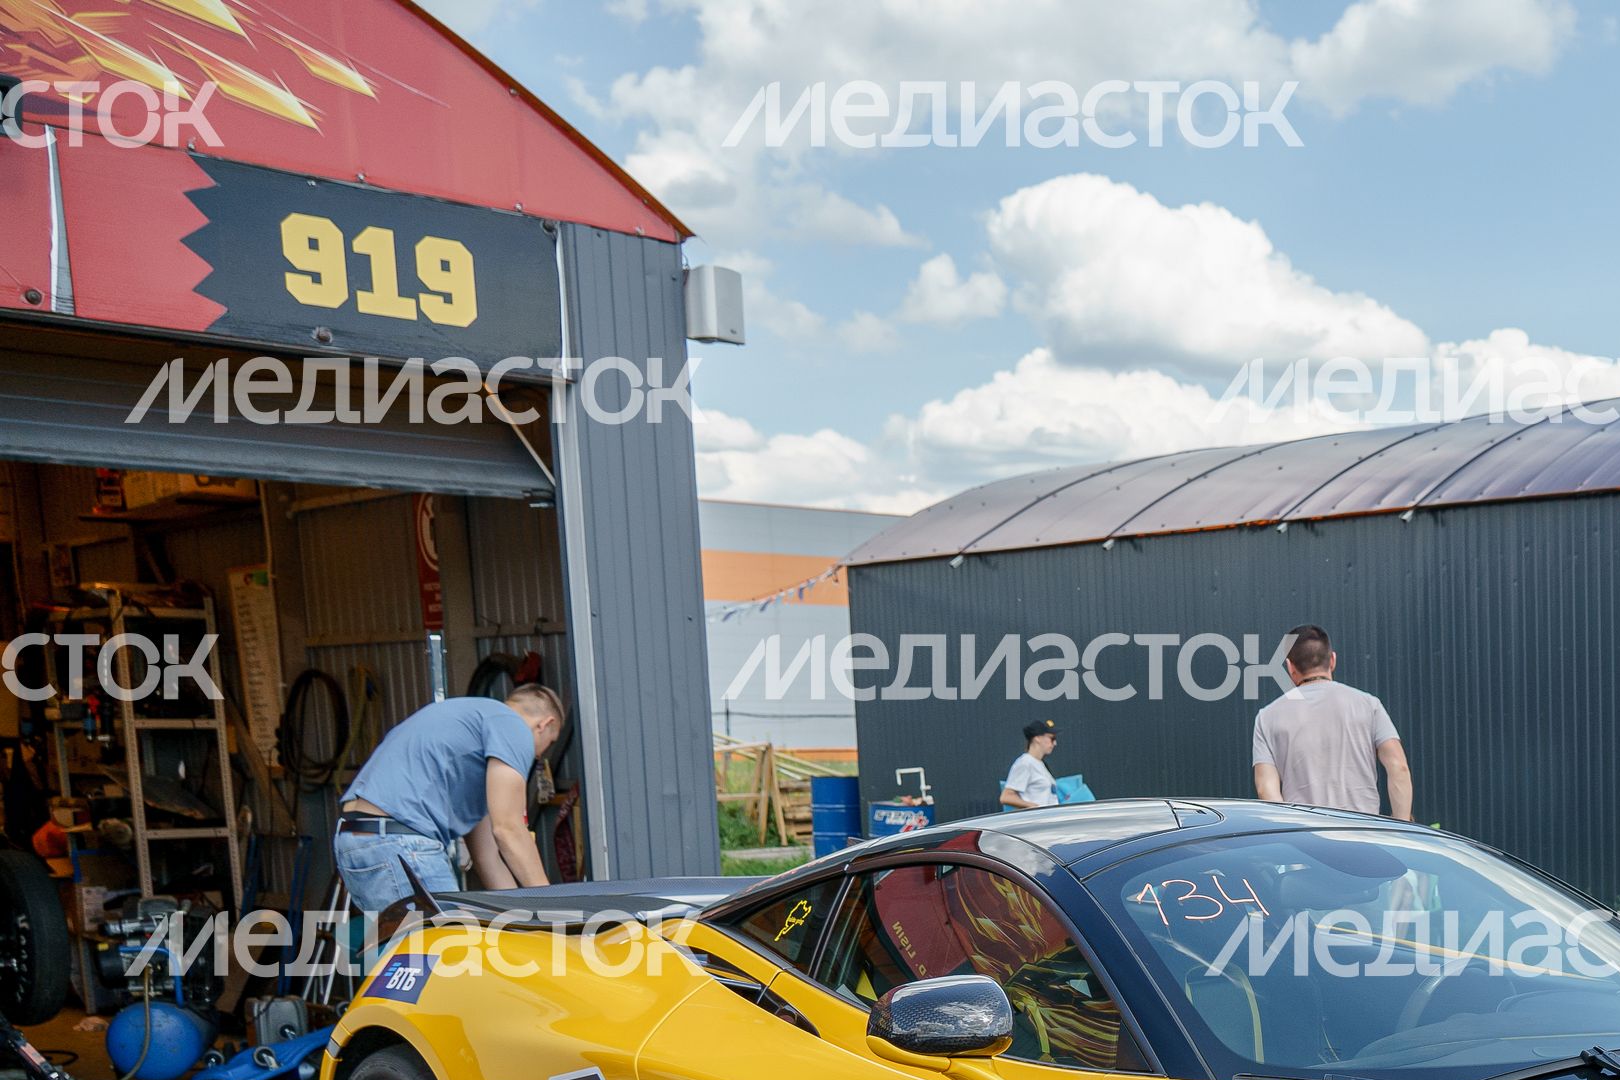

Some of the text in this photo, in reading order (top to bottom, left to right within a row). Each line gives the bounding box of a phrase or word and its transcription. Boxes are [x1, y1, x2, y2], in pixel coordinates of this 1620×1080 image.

[280, 212, 478, 328] 919
[1136, 875, 1270, 926] 134
[385, 967, 422, 991] ВТБ
